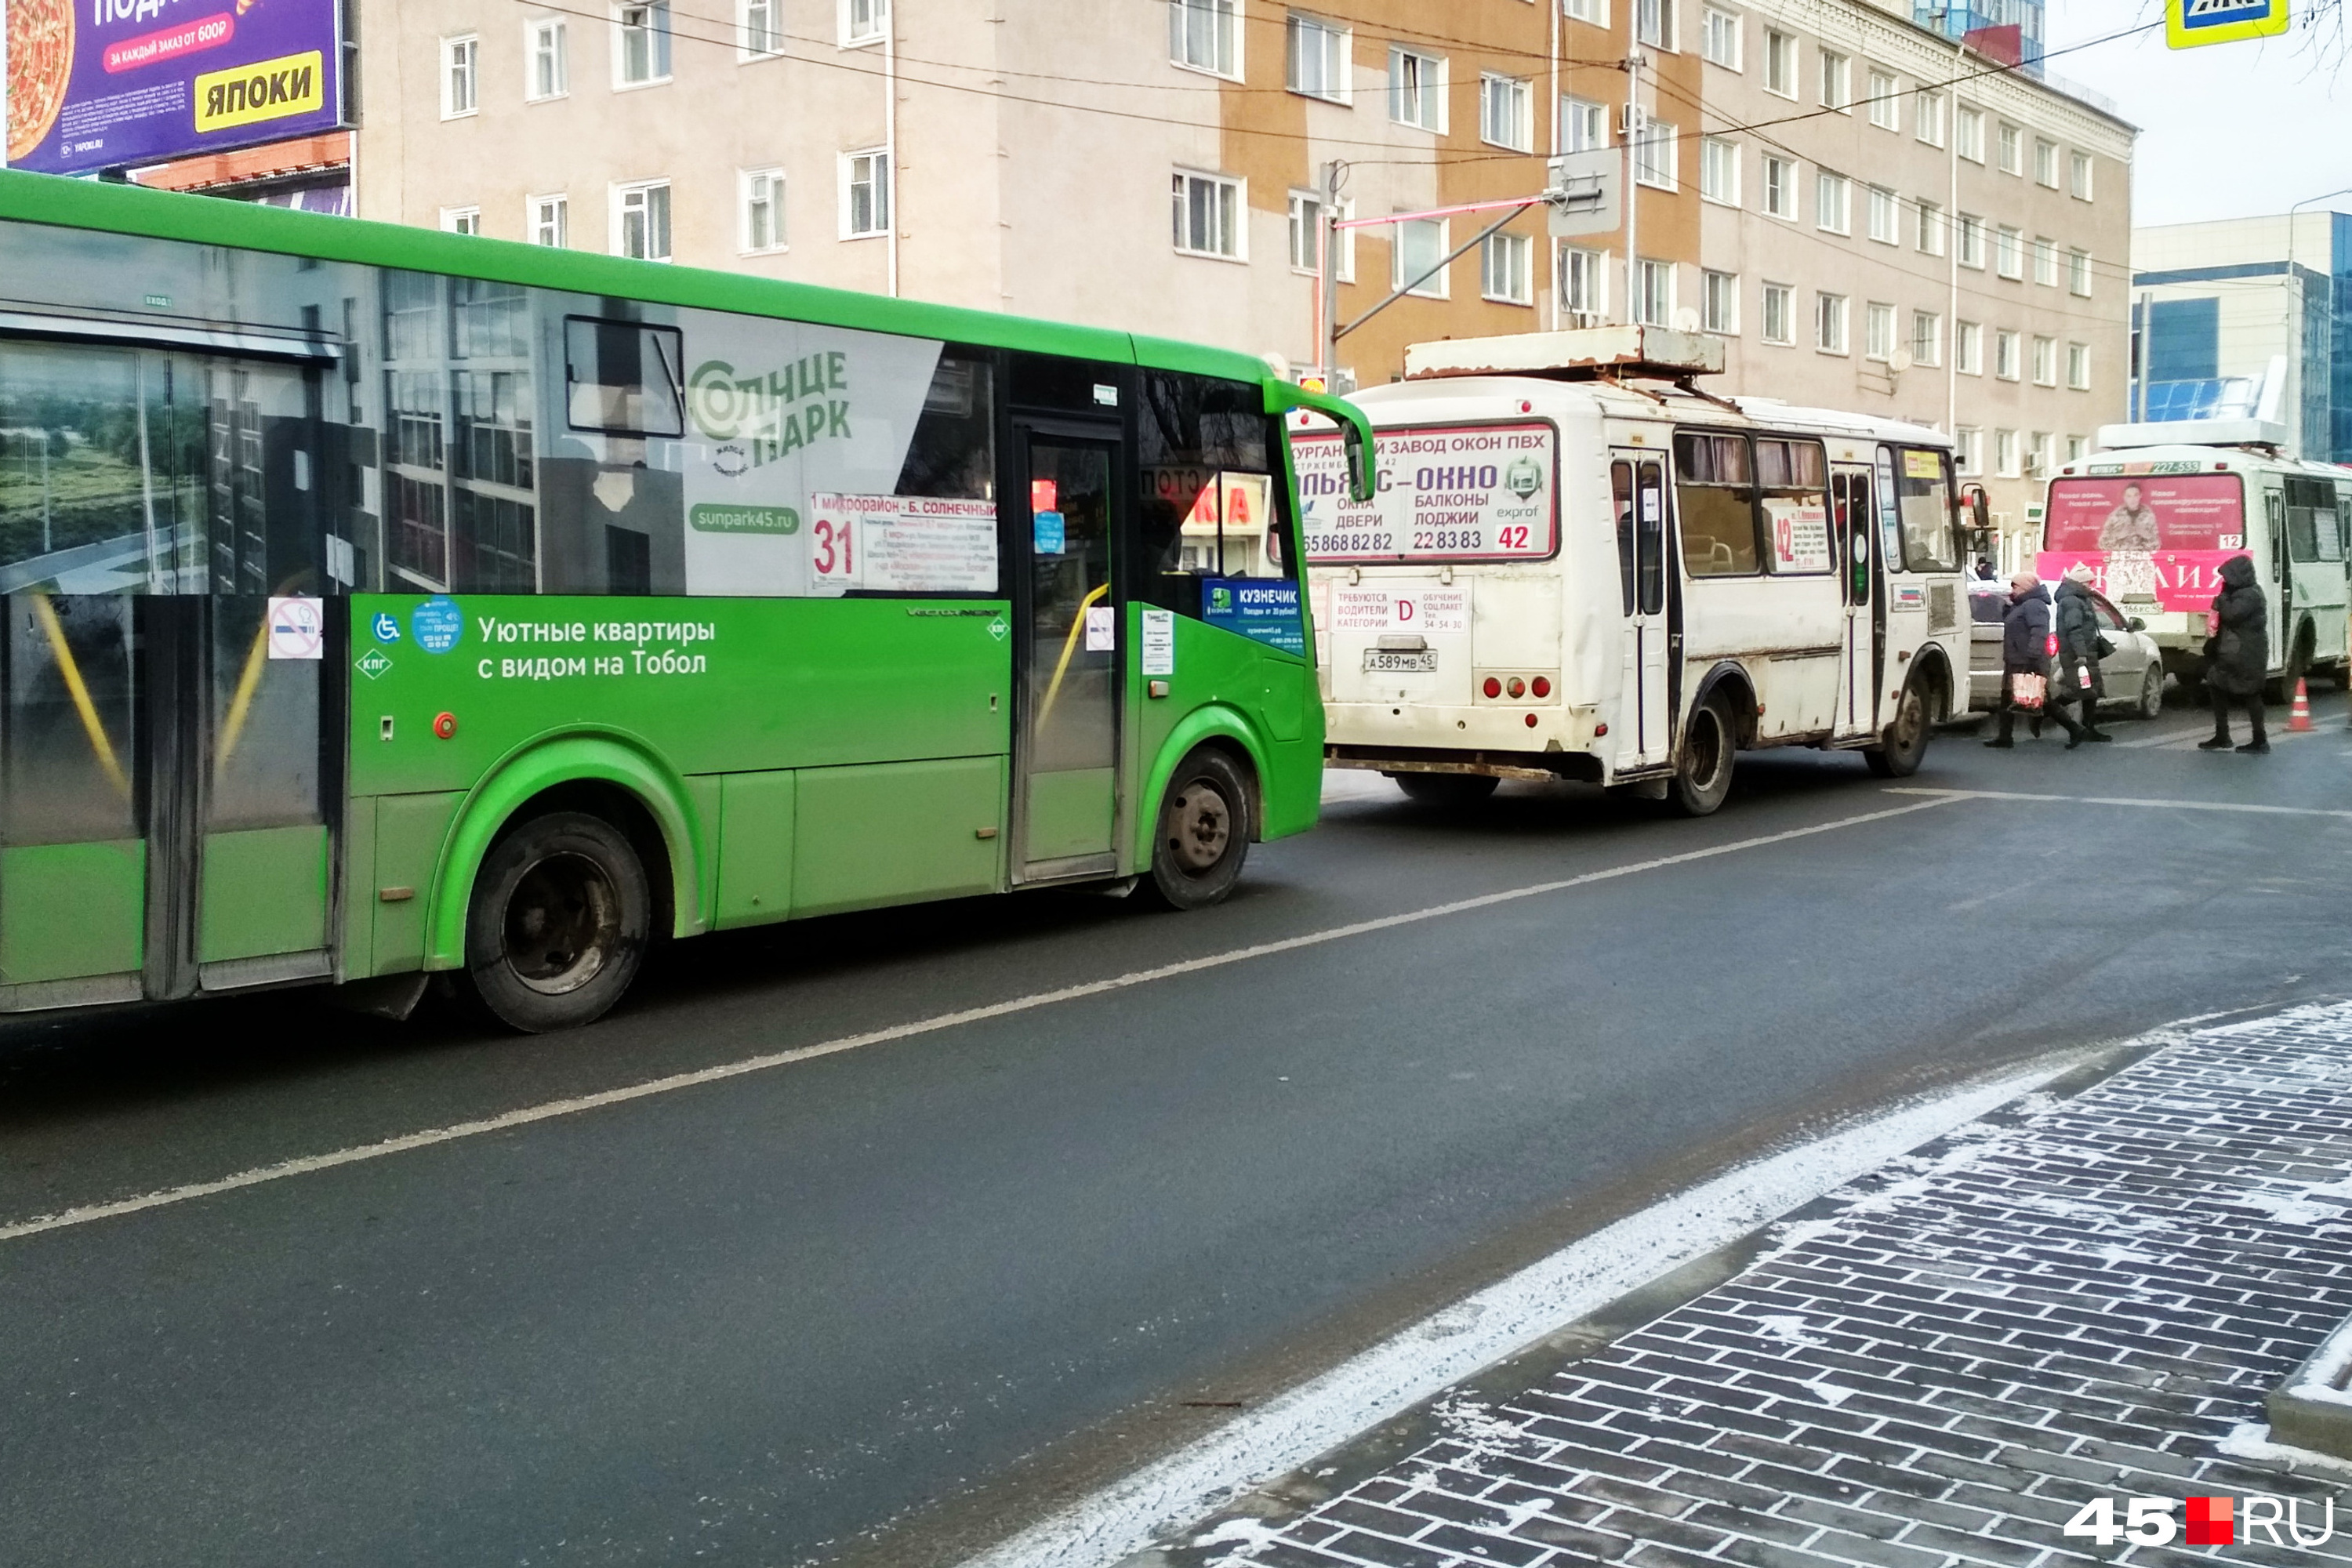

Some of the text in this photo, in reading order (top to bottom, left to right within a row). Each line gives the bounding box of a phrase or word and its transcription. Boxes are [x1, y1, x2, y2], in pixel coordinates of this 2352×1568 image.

[111, 20, 227, 66] ЗА КАЖДЫЙ ЗАКАЗ ОТ 600₽
[205, 65, 311, 118] ЯПОКИ
[753, 401, 852, 468] ПАРК
[1390, 439, 1446, 455] ЗАВОД
[1452, 437, 1502, 451] ОКОН
[1508, 435, 1545, 448] ПВХ
[2154, 462, 2199, 471] 227-533
[811, 495, 817, 510] 1
[822, 496, 899, 515] микрорайон
[909, 501, 919, 514] Б.
[1415, 493, 1489, 507] БАЛКОНЫ
[699, 510, 792, 529] sunpark45.ru
[1414, 511, 1479, 527] ЛОДЖИИ
[1497, 505, 1539, 520] exprof
[1336, 514, 1382, 530] ДВЕРИ
[1499, 526, 1528, 549] 42
[1777, 518, 1794, 561] 42
[2223, 535, 2238, 546] 12
[814, 520, 852, 574] 31
[1240, 590, 1297, 603] КУЗНЕЧИК
[1338, 593, 1387, 602] ТРЕБУЮТСЯ
[1338, 605, 1388, 615] ВОДИТЕЛИ
[477, 617, 714, 647] Уютные квартиры
[1337, 619, 1388, 628] КАТЕГОРИИ
[363, 659, 386, 670] КПГ
[478, 649, 706, 681] с видом на Тобол
